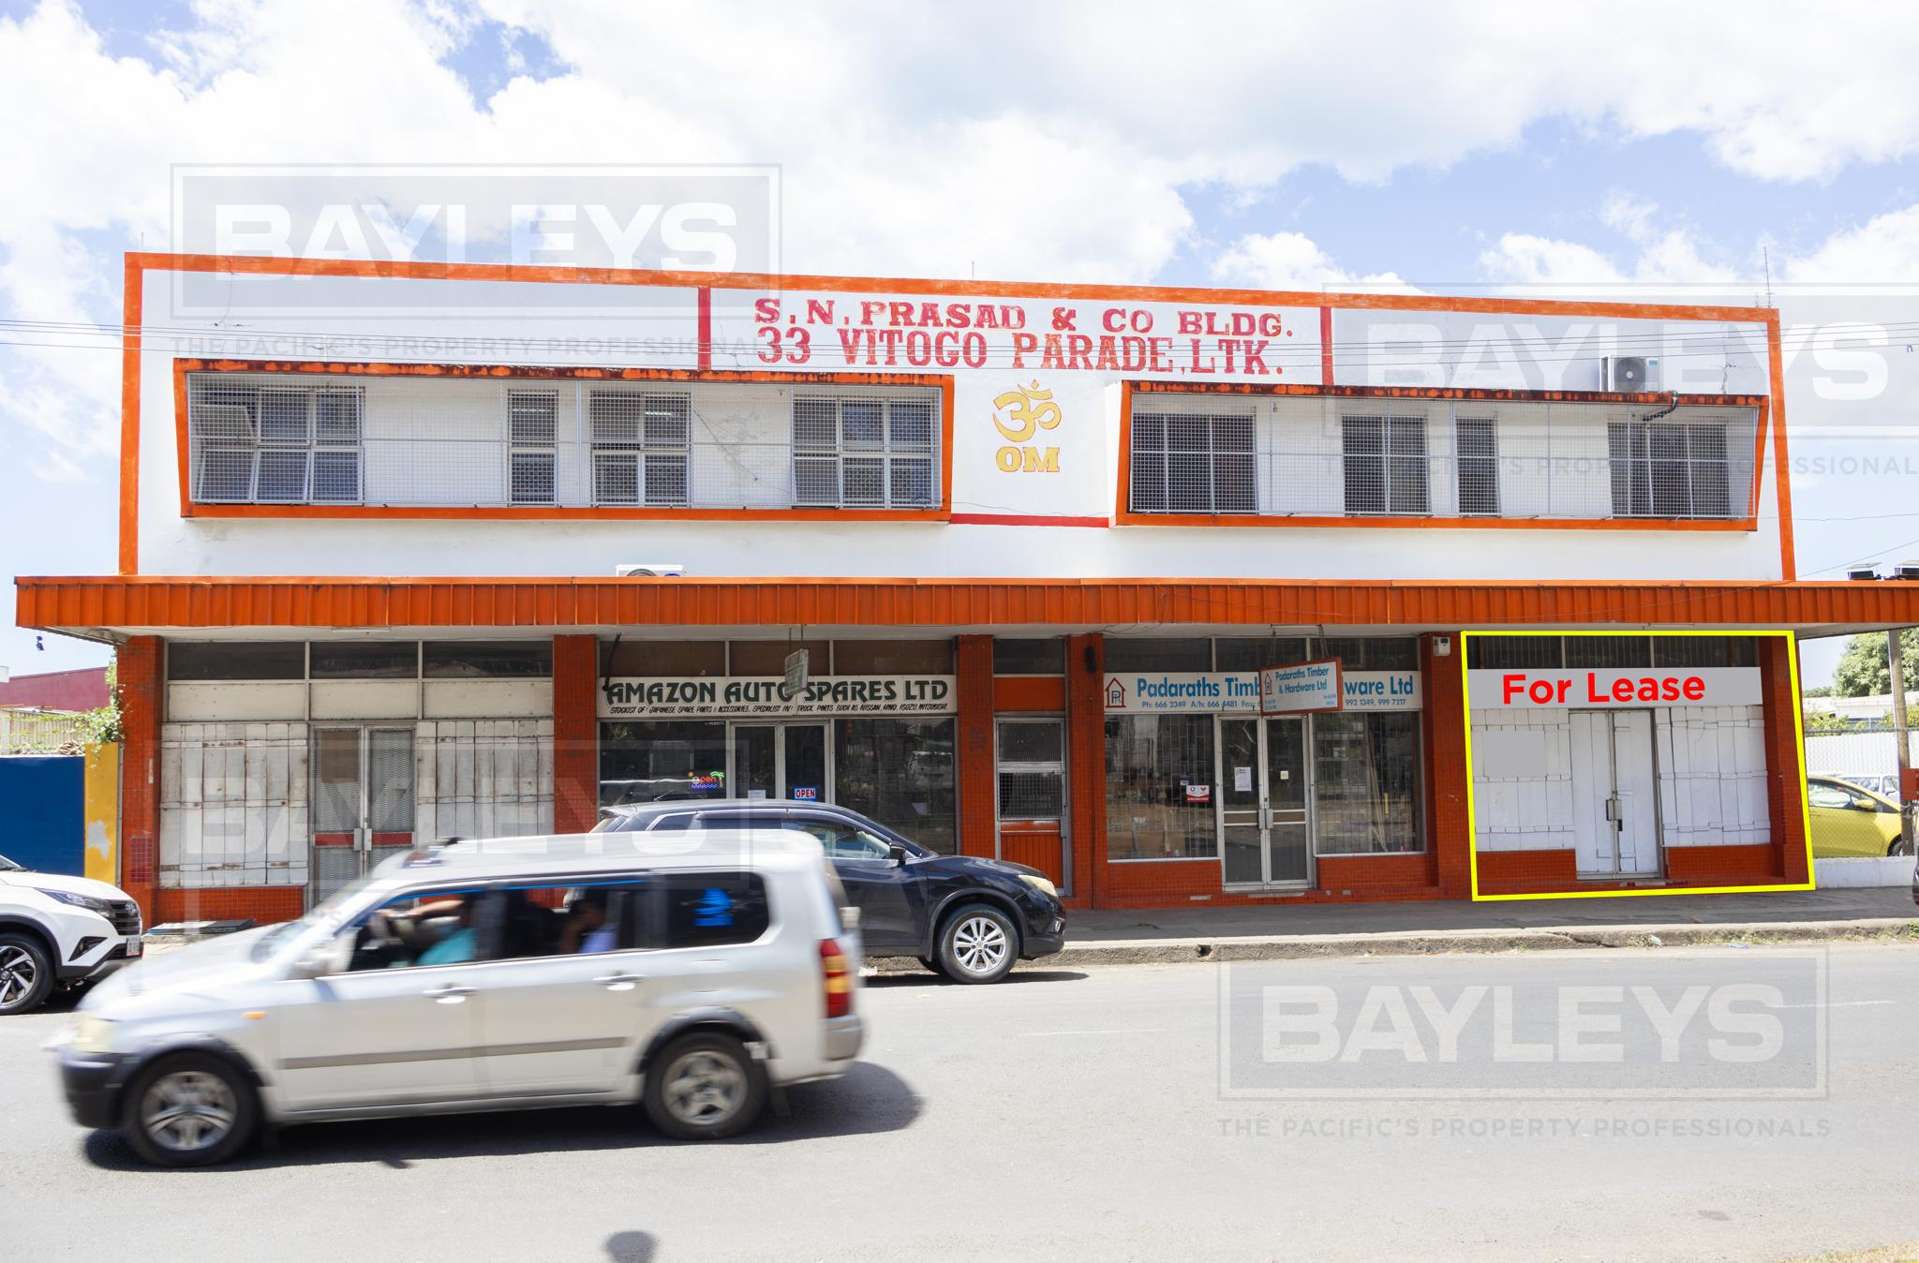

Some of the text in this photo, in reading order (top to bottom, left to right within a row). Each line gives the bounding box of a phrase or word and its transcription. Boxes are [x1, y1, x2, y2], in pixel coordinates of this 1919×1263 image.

[1051, 307, 1076, 332] &
[1103, 308, 1154, 334] CO
[1177, 311, 1293, 337] BLDG.
[757, 326, 812, 364] 33
[837, 328, 988, 369] VITOGO
[996, 447, 1061, 473] OM
[606, 679, 949, 705] AMAZON AUTO SPARES LTD
[1137, 676, 1220, 697] Padaraths
[1390, 675, 1414, 695] Ltd
[795, 788, 816, 799] OPEN
